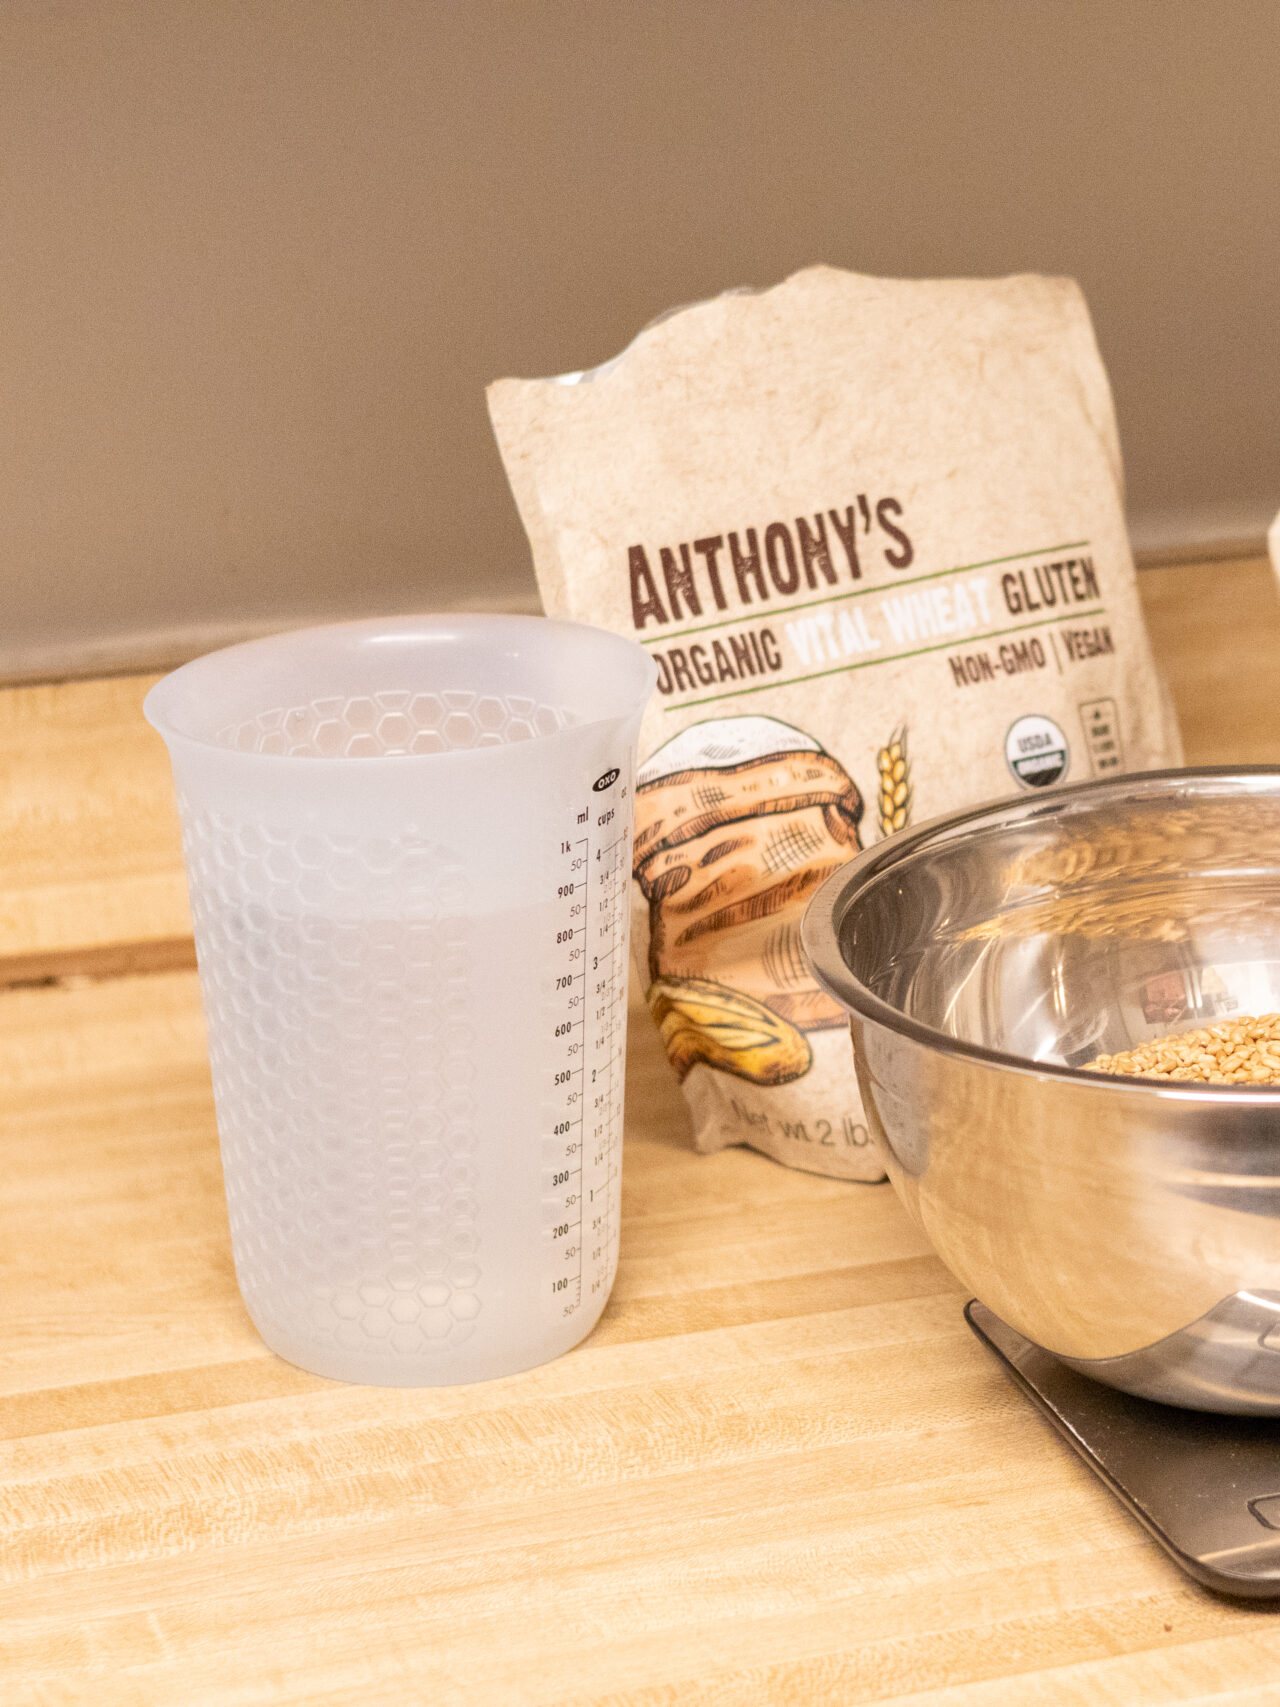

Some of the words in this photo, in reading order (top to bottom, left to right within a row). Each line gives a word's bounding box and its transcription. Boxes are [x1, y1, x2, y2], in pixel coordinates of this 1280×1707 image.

[628, 494, 914, 630] ANTHONY'S
[651, 628, 782, 695] ORGANIC
[784, 605, 881, 666] VITAL
[880, 577, 991, 643] WHEAT
[1001, 556, 1101, 615] GLUTEN
[948, 637, 1046, 688] NON-GMO
[1060, 626, 1116, 662] VEGAN
[1016, 732, 1053, 753] USDA
[597, 771, 617, 789] OXO
[577, 805, 589, 825] ml
[597, 808, 615, 827] cups
[561, 840, 571, 854] 1k
[596, 849, 601, 862] 4
[570, 858, 582, 871] 50
[557, 883, 574, 898] 900
[569, 904, 580, 917] 50
[556, 928, 573, 944] 800
[568, 948, 580, 961] 50
[556, 974, 572, 991] 700
[568, 996, 579, 1009] 50
[554, 1021, 571, 1037] 600
[567, 1042, 579, 1057] 50
[554, 1069, 571, 1086] 500
[566, 1092, 578, 1106] 50
[553, 1120, 570, 1136] 400
[815, 1119, 836, 1147] 2
[565, 1143, 577, 1157] 50
[552, 1170, 569, 1187] 300
[565, 1194, 576, 1208] 50
[552, 1223, 569, 1239] 200
[552, 1277, 568, 1293] 100
